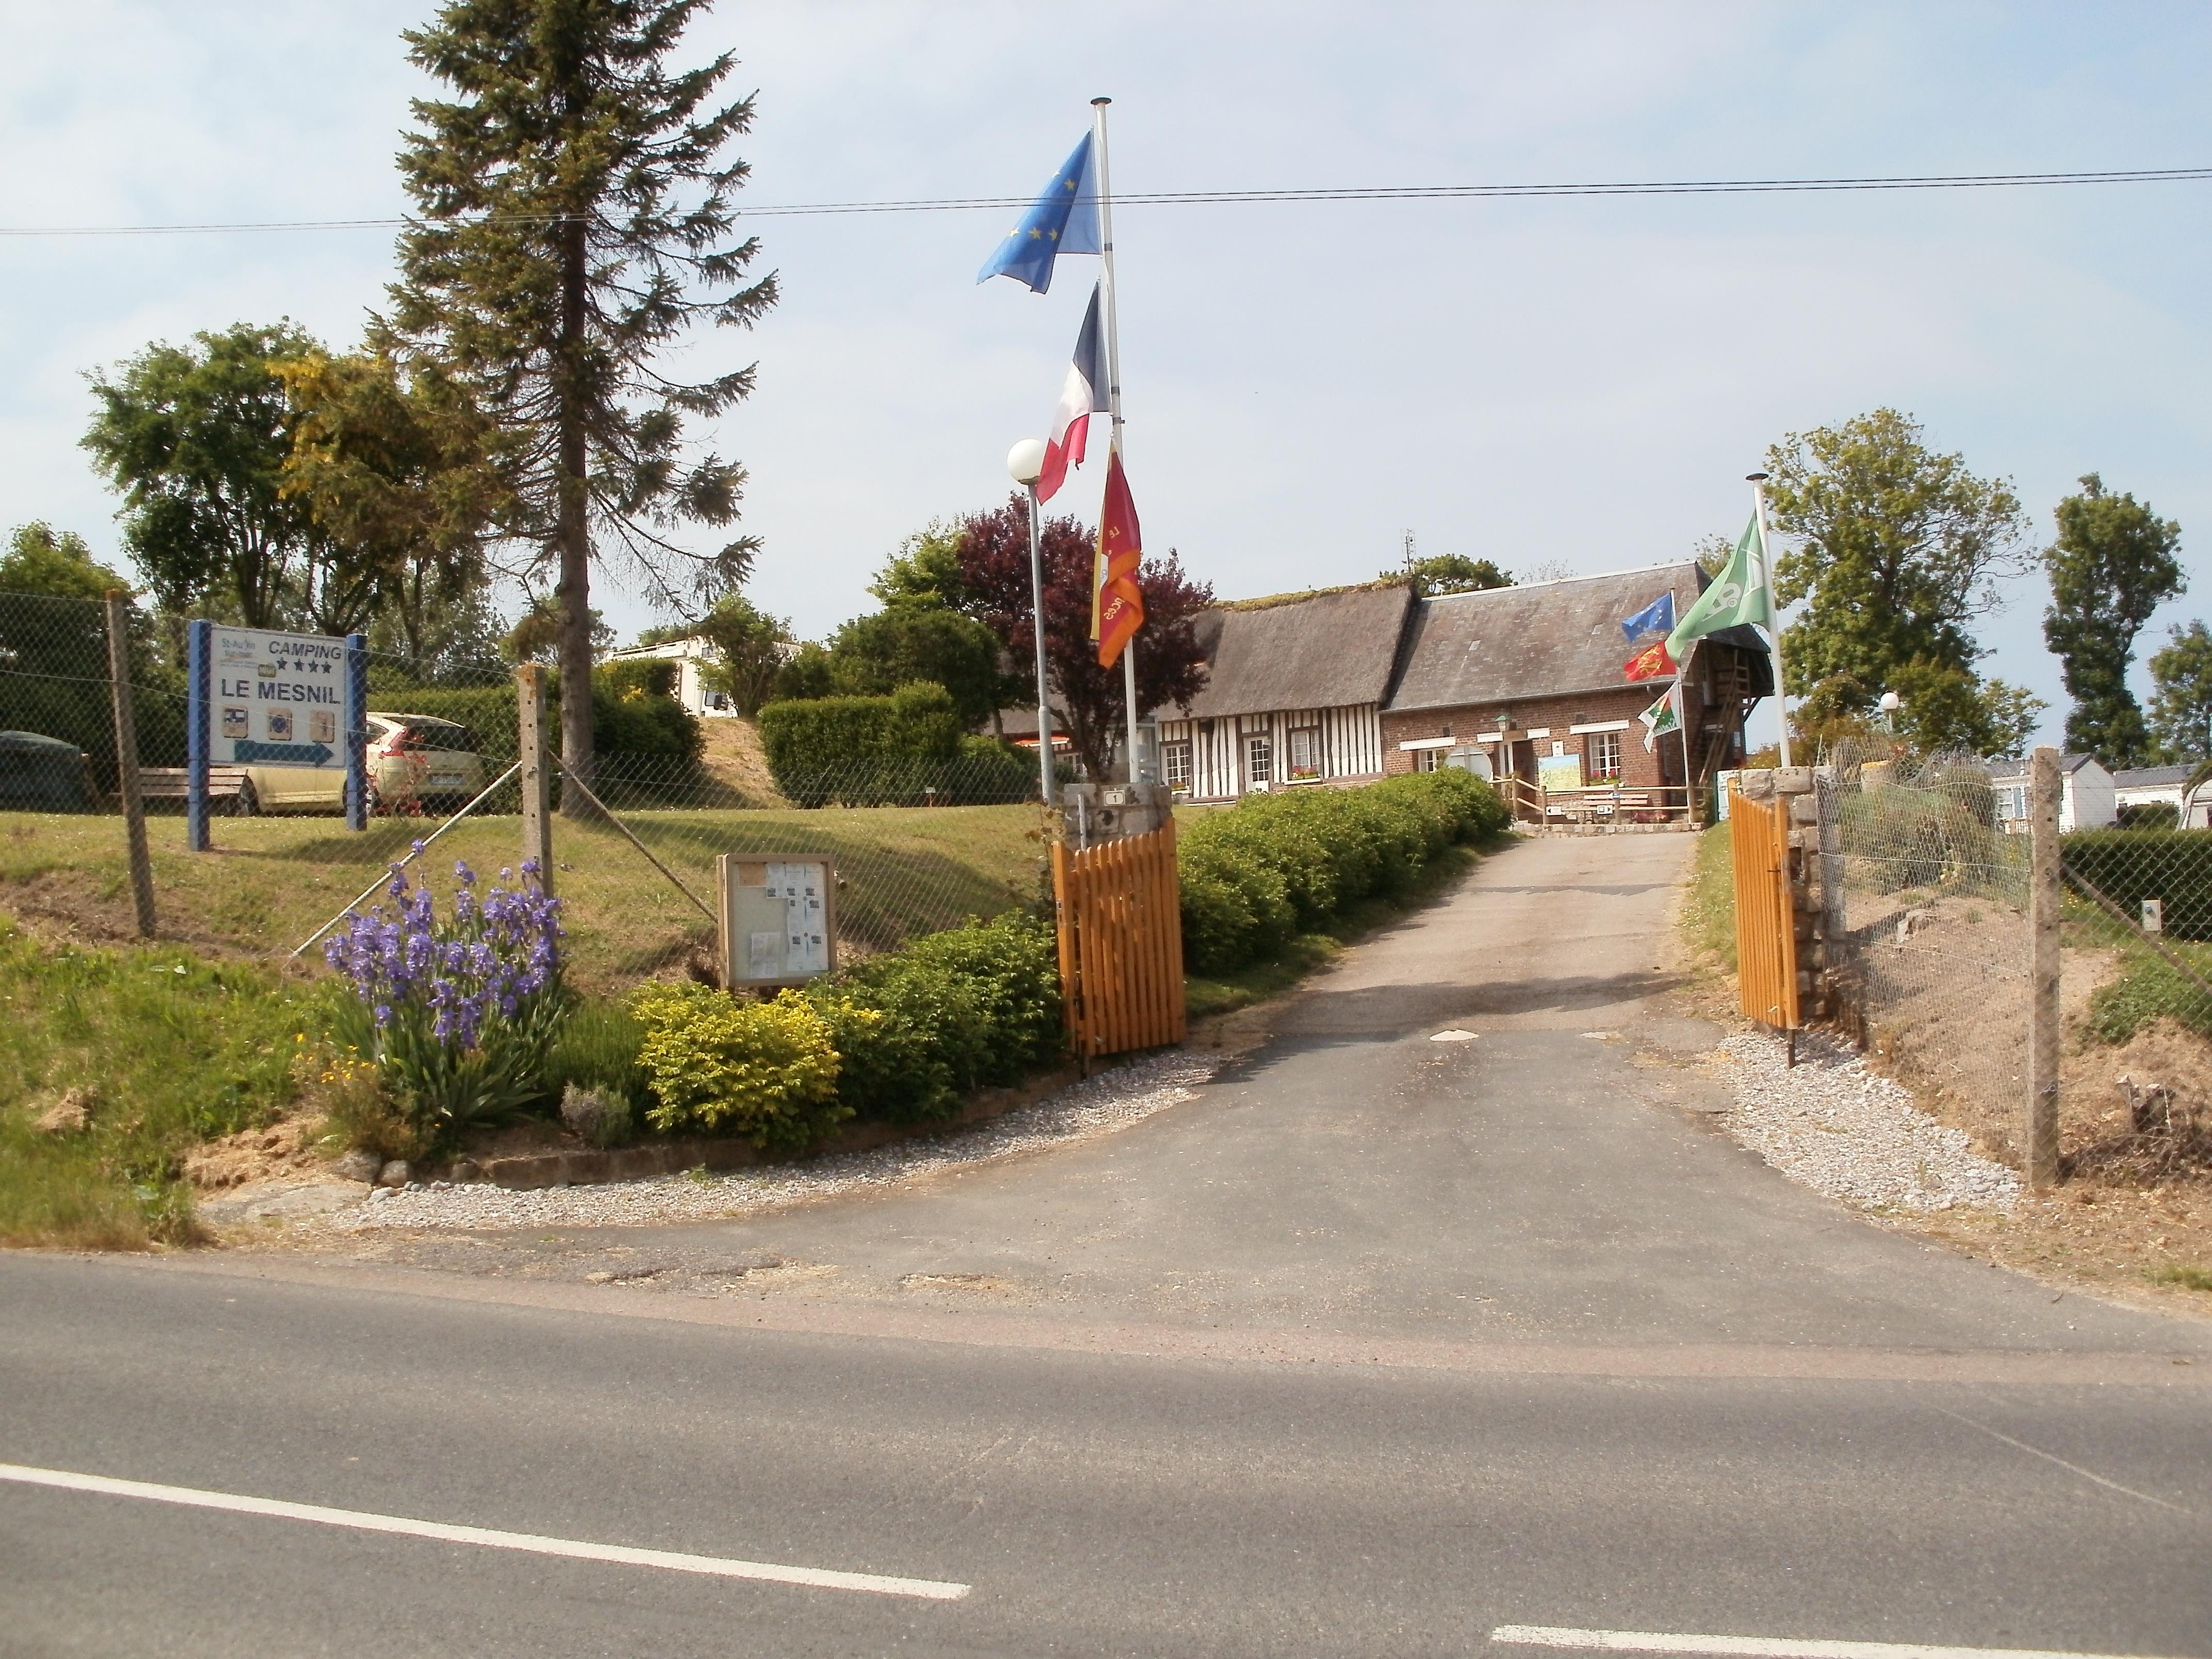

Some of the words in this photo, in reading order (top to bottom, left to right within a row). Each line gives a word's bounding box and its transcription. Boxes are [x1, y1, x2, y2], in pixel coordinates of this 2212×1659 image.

[269, 641, 341, 659] CAMPING
[222, 679, 250, 698] LE
[258, 681, 340, 704] MESNIL
